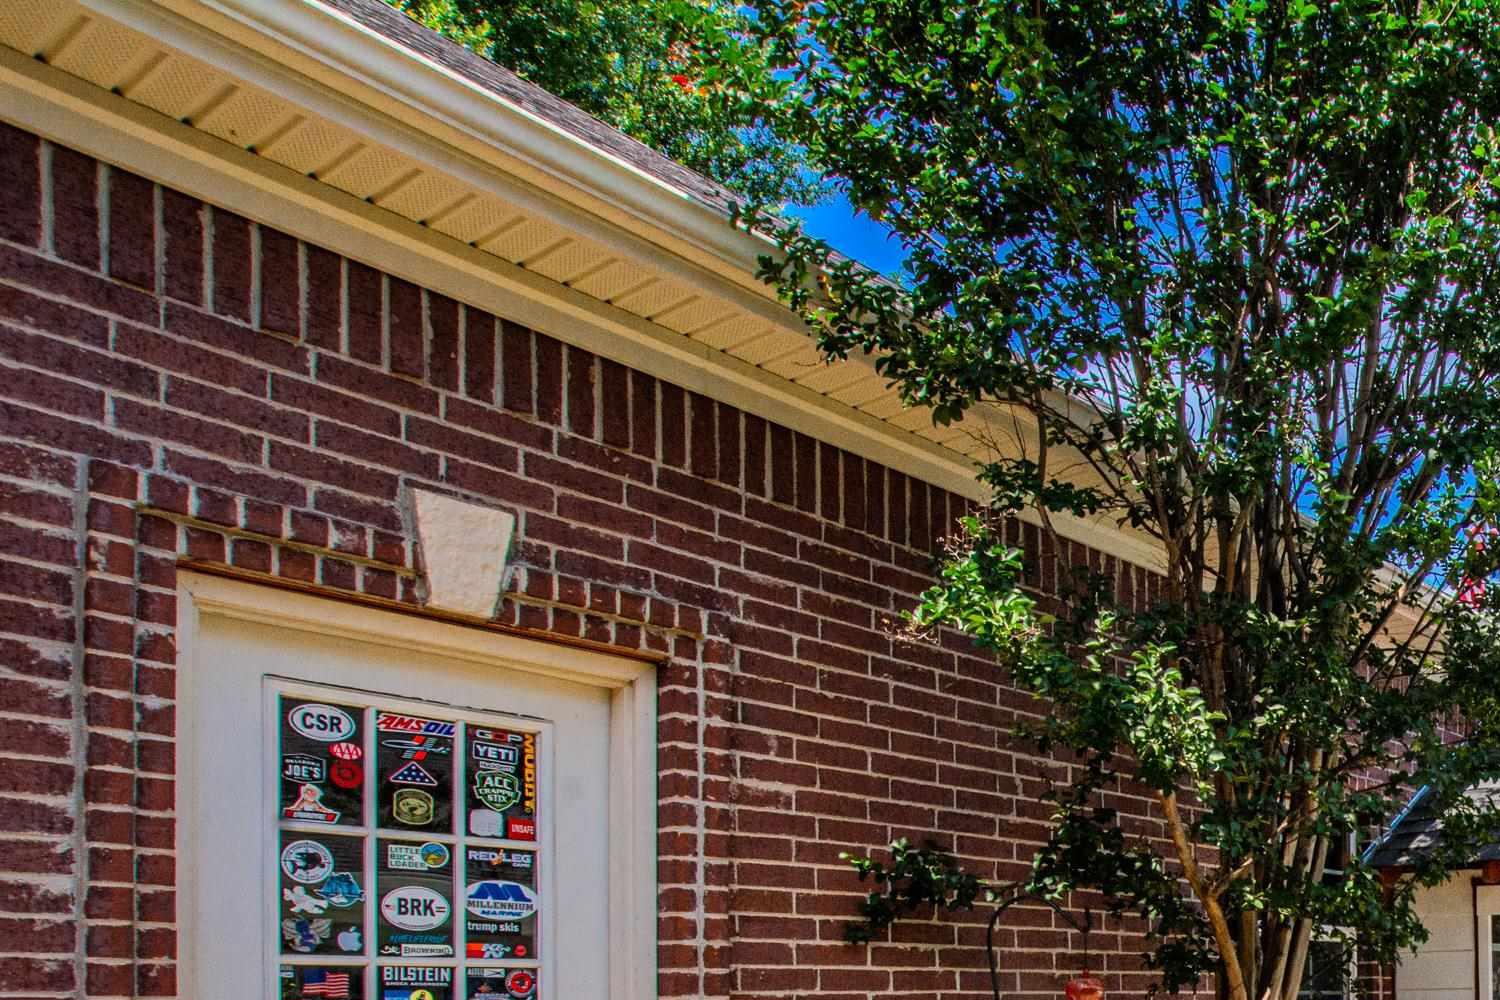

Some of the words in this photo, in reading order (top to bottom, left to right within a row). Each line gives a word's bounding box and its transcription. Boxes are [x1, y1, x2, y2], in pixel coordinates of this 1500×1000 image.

[302, 712, 342, 733] CSR
[377, 714, 456, 737] AMSOIL
[475, 744, 515, 761] YETI
[285, 764, 320, 779] JOE'S
[484, 776, 513, 790] ACC
[397, 897, 436, 917] BRK
[466, 899, 534, 912] MILLENNIUM
[467, 921, 498, 933] trump
[499, 923, 520, 932] skis
[383, 966, 451, 981] BILSTEIN
